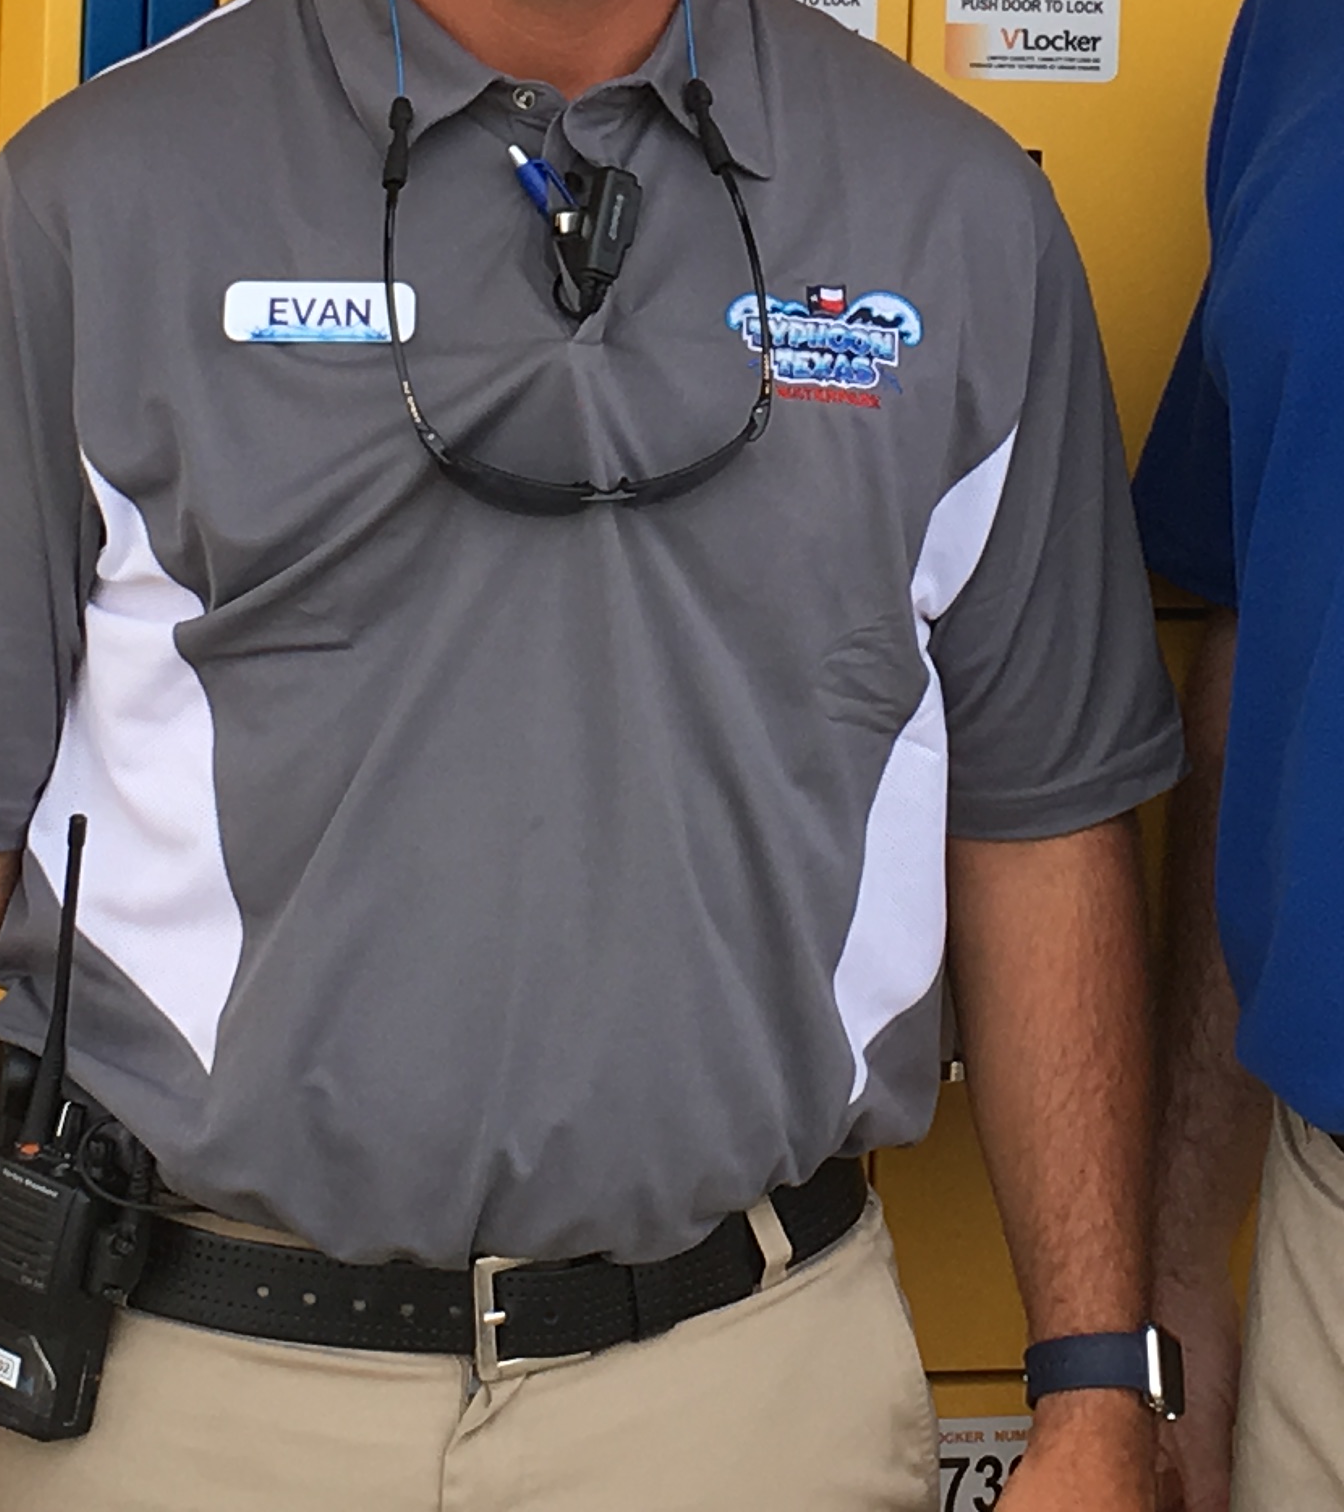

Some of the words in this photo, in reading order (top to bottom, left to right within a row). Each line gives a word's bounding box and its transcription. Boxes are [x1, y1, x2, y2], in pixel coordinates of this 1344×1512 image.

[1001, 0, 1041, 13] DOOR
[1045, 0, 1063, 13] TO
[1066, 1, 1103, 14] LOCK
[1001, 28, 1102, 53] VLocker
[269, 297, 371, 326] EVAN
[774, 348, 876, 384] TEXAS
